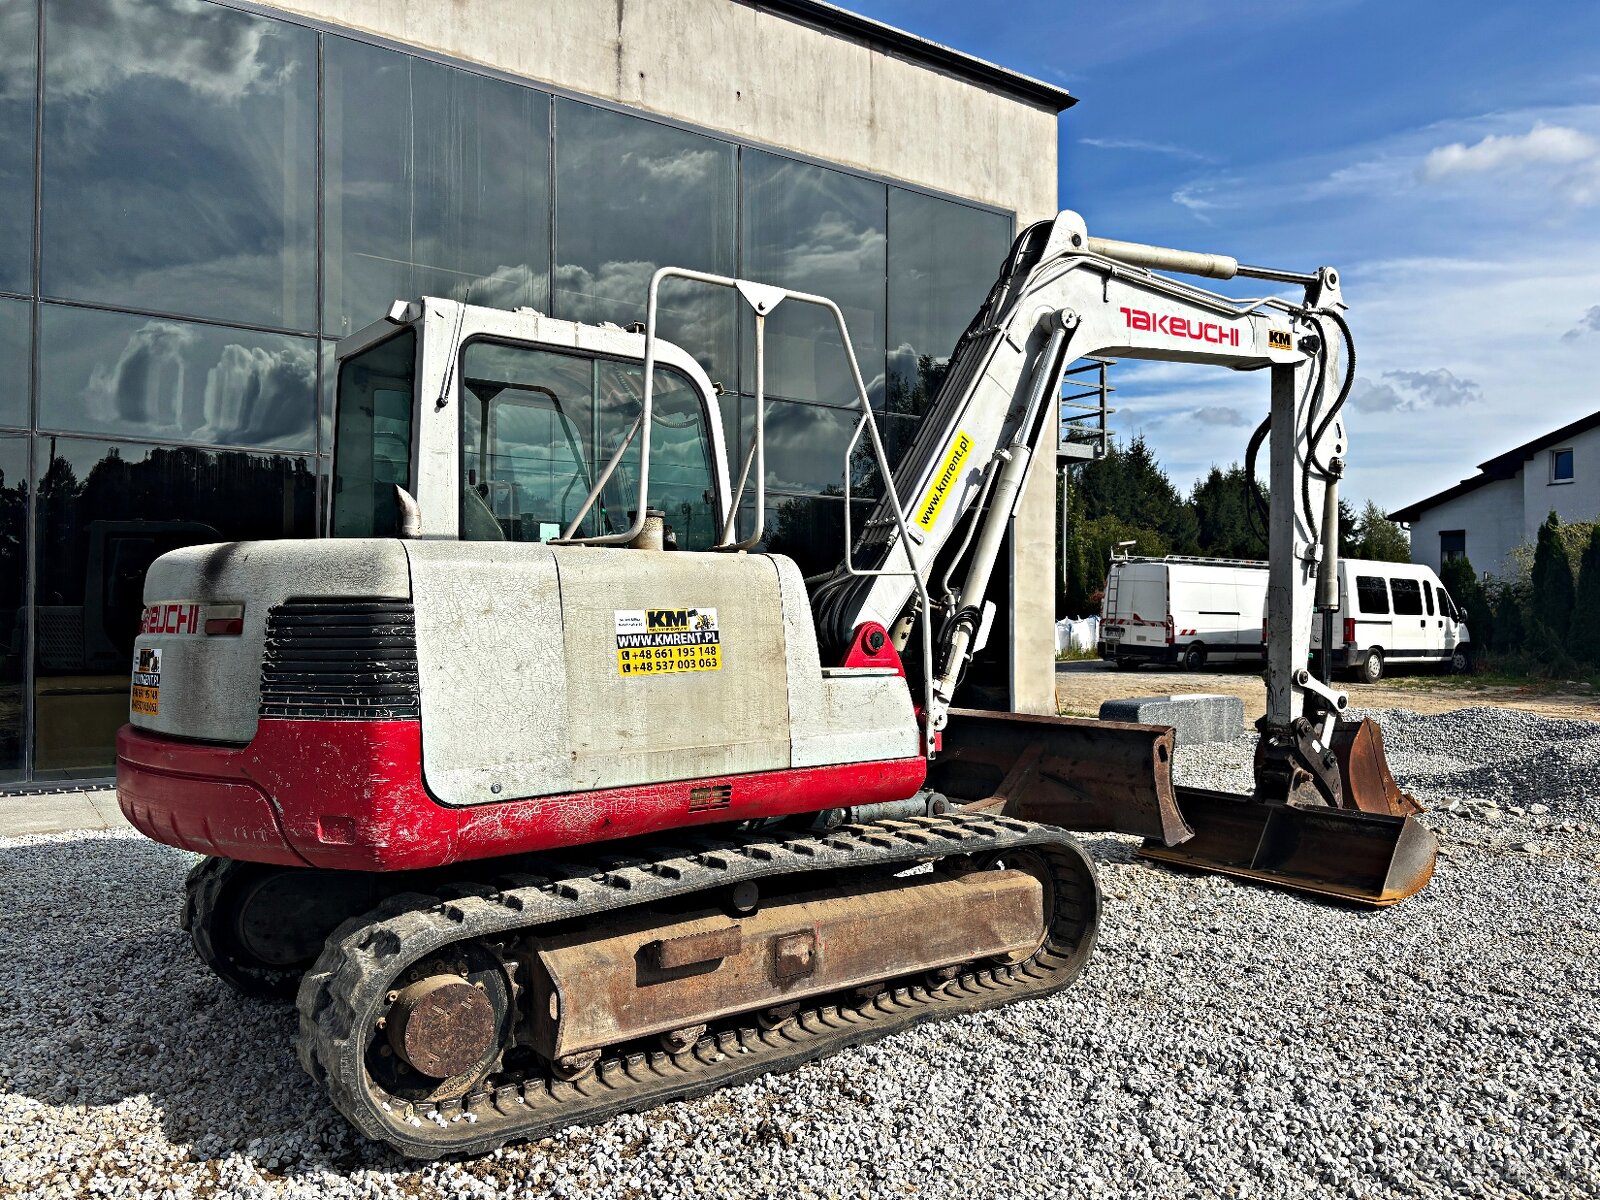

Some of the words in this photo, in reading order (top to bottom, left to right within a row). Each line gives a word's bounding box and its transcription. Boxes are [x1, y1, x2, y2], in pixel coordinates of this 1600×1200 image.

[1120, 307, 1239, 347] TAKEUCHI
[1269, 331, 1291, 345] KM
[921, 436, 970, 524] www.kmrent.pl
[647, 610, 688, 628] KM
[617, 632, 719, 648] WWW.KMRENT.PL
[632, 650, 652, 660] +48
[655, 649, 673, 658] 661
[677, 648, 695, 657] 195
[699, 646, 717, 656] 148
[633, 662, 653, 672] +48
[656, 661, 674, 671] 537
[678, 660, 696, 669] 003
[699, 658, 717, 668] 063
